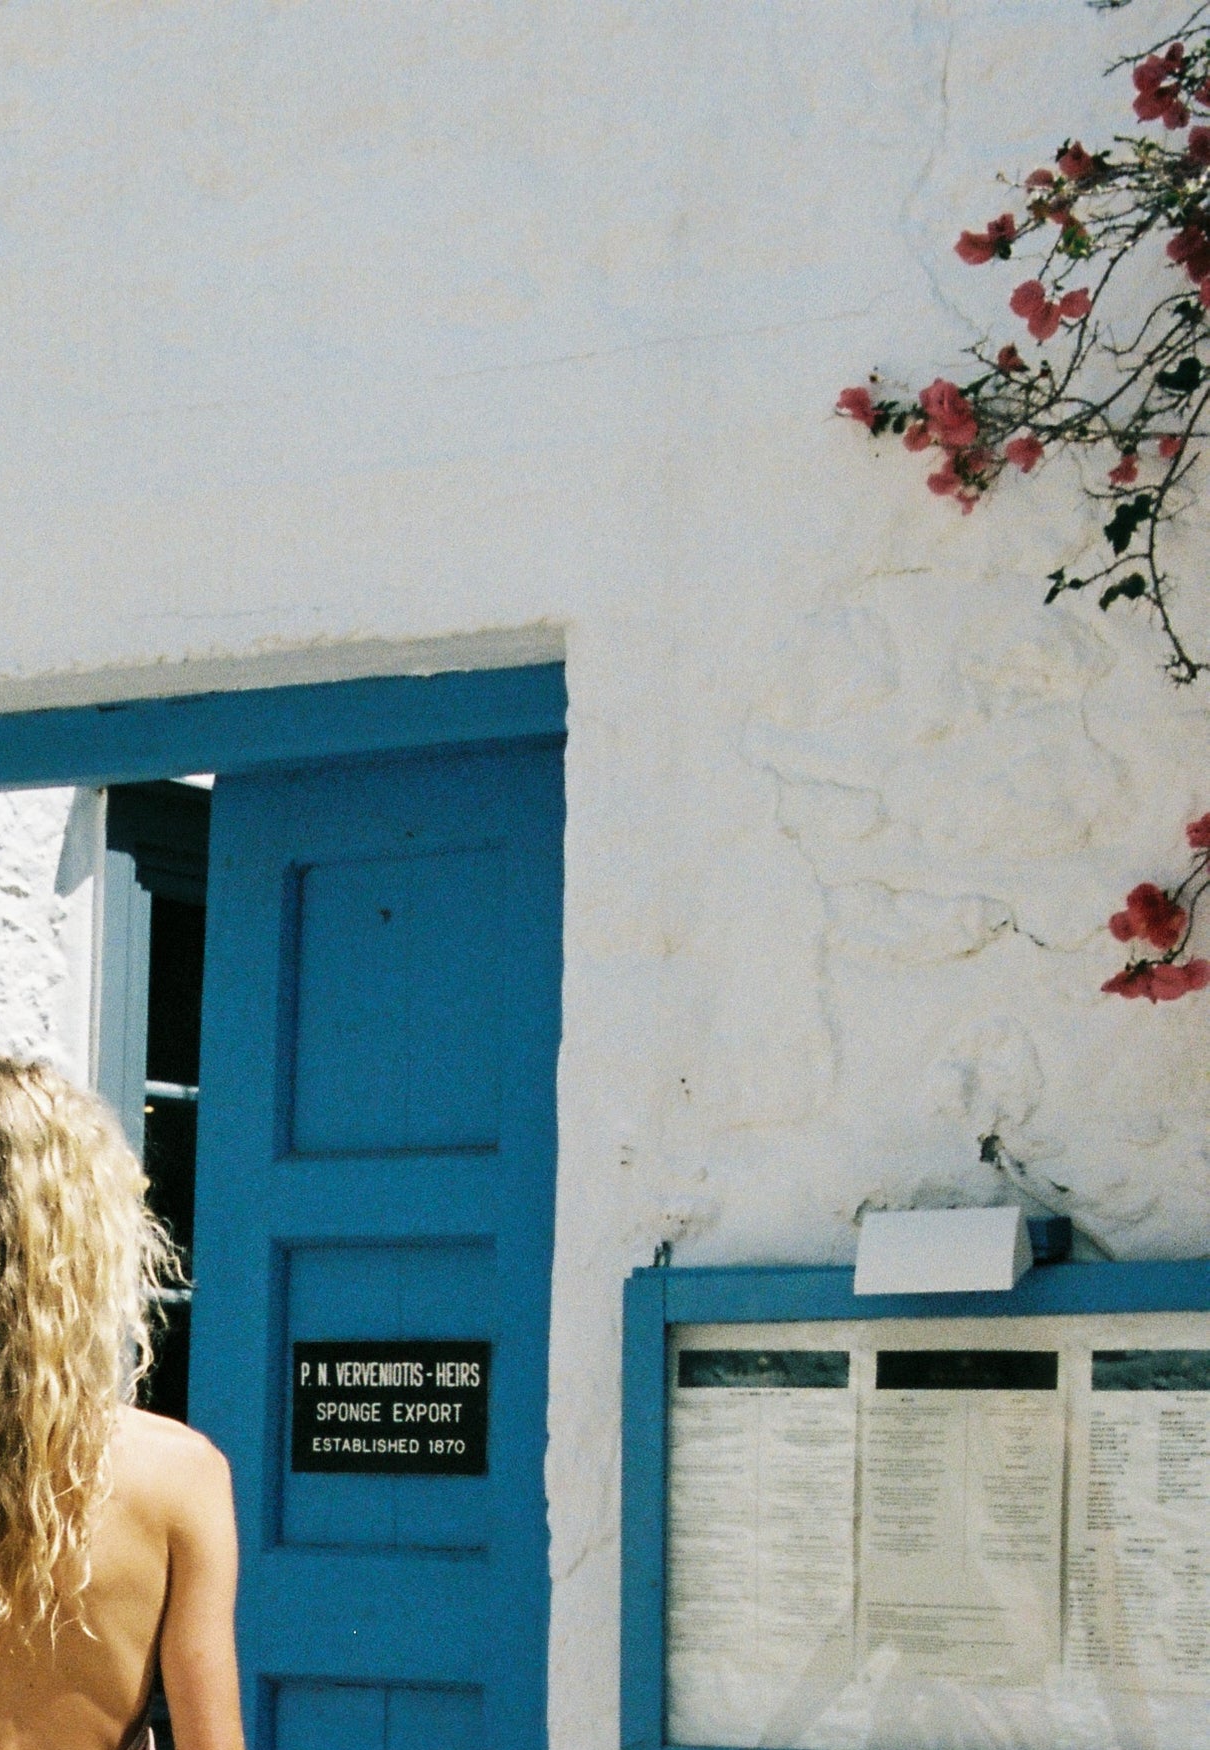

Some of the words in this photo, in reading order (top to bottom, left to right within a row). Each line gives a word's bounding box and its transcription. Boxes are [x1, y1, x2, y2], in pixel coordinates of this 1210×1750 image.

[300, 1362, 312, 1387] P.
[317, 1362, 331, 1387] N.
[435, 1362, 480, 1388] HEIRS
[316, 1402, 382, 1423] SPONGE
[393, 1402, 463, 1423] EXPORT
[312, 1436, 420, 1455] ESTABLISHED
[428, 1438, 466, 1455] 1870
